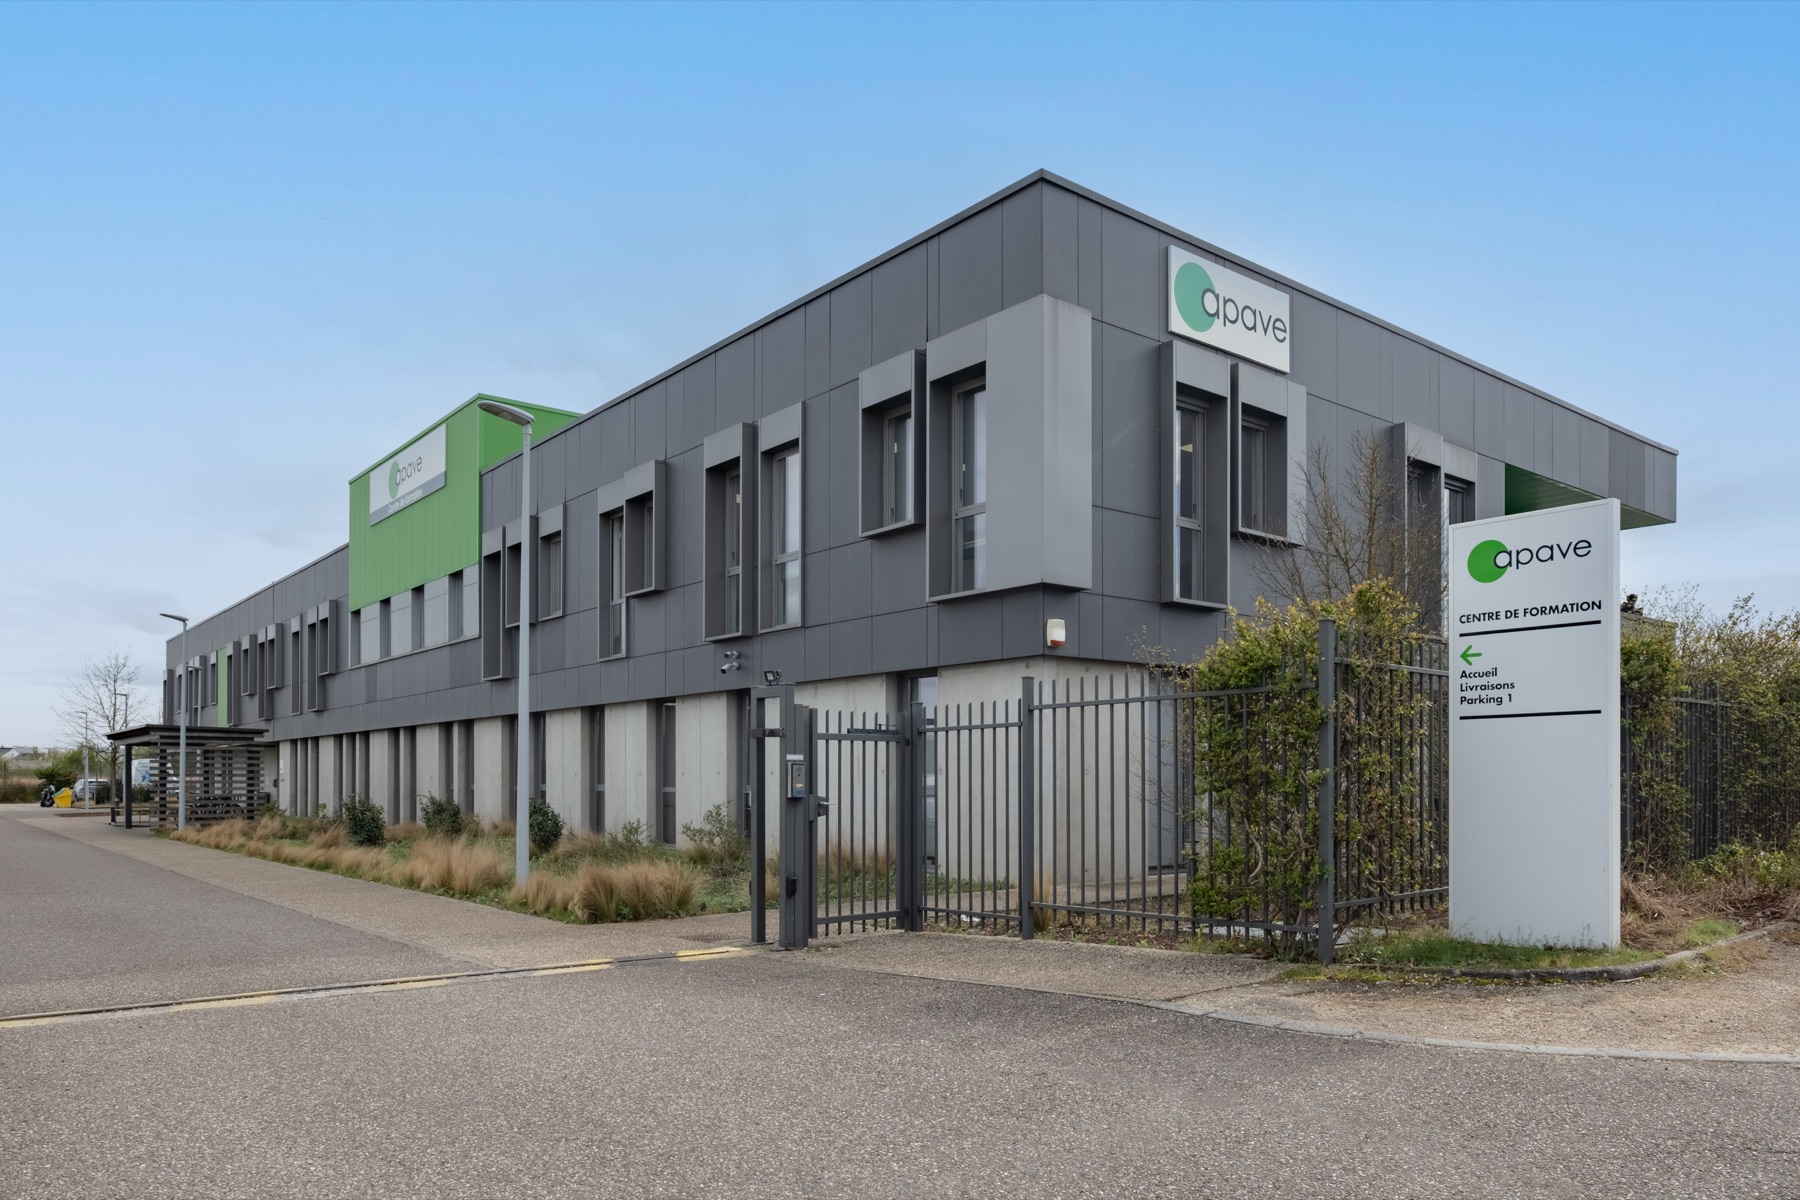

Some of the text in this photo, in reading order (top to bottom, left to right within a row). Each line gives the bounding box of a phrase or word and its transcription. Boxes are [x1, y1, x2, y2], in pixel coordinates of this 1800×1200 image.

[1201, 288, 1287, 343] apave
[395, 456, 423, 486] apave
[1493, 539, 1592, 570] apave
[1459, 600, 1602, 624] CENTRE DE FORMATION
[1460, 667, 1498, 679] Accueil
[1460, 681, 1516, 692] Livraisons
[1460, 693, 1513, 706] Parking 1
